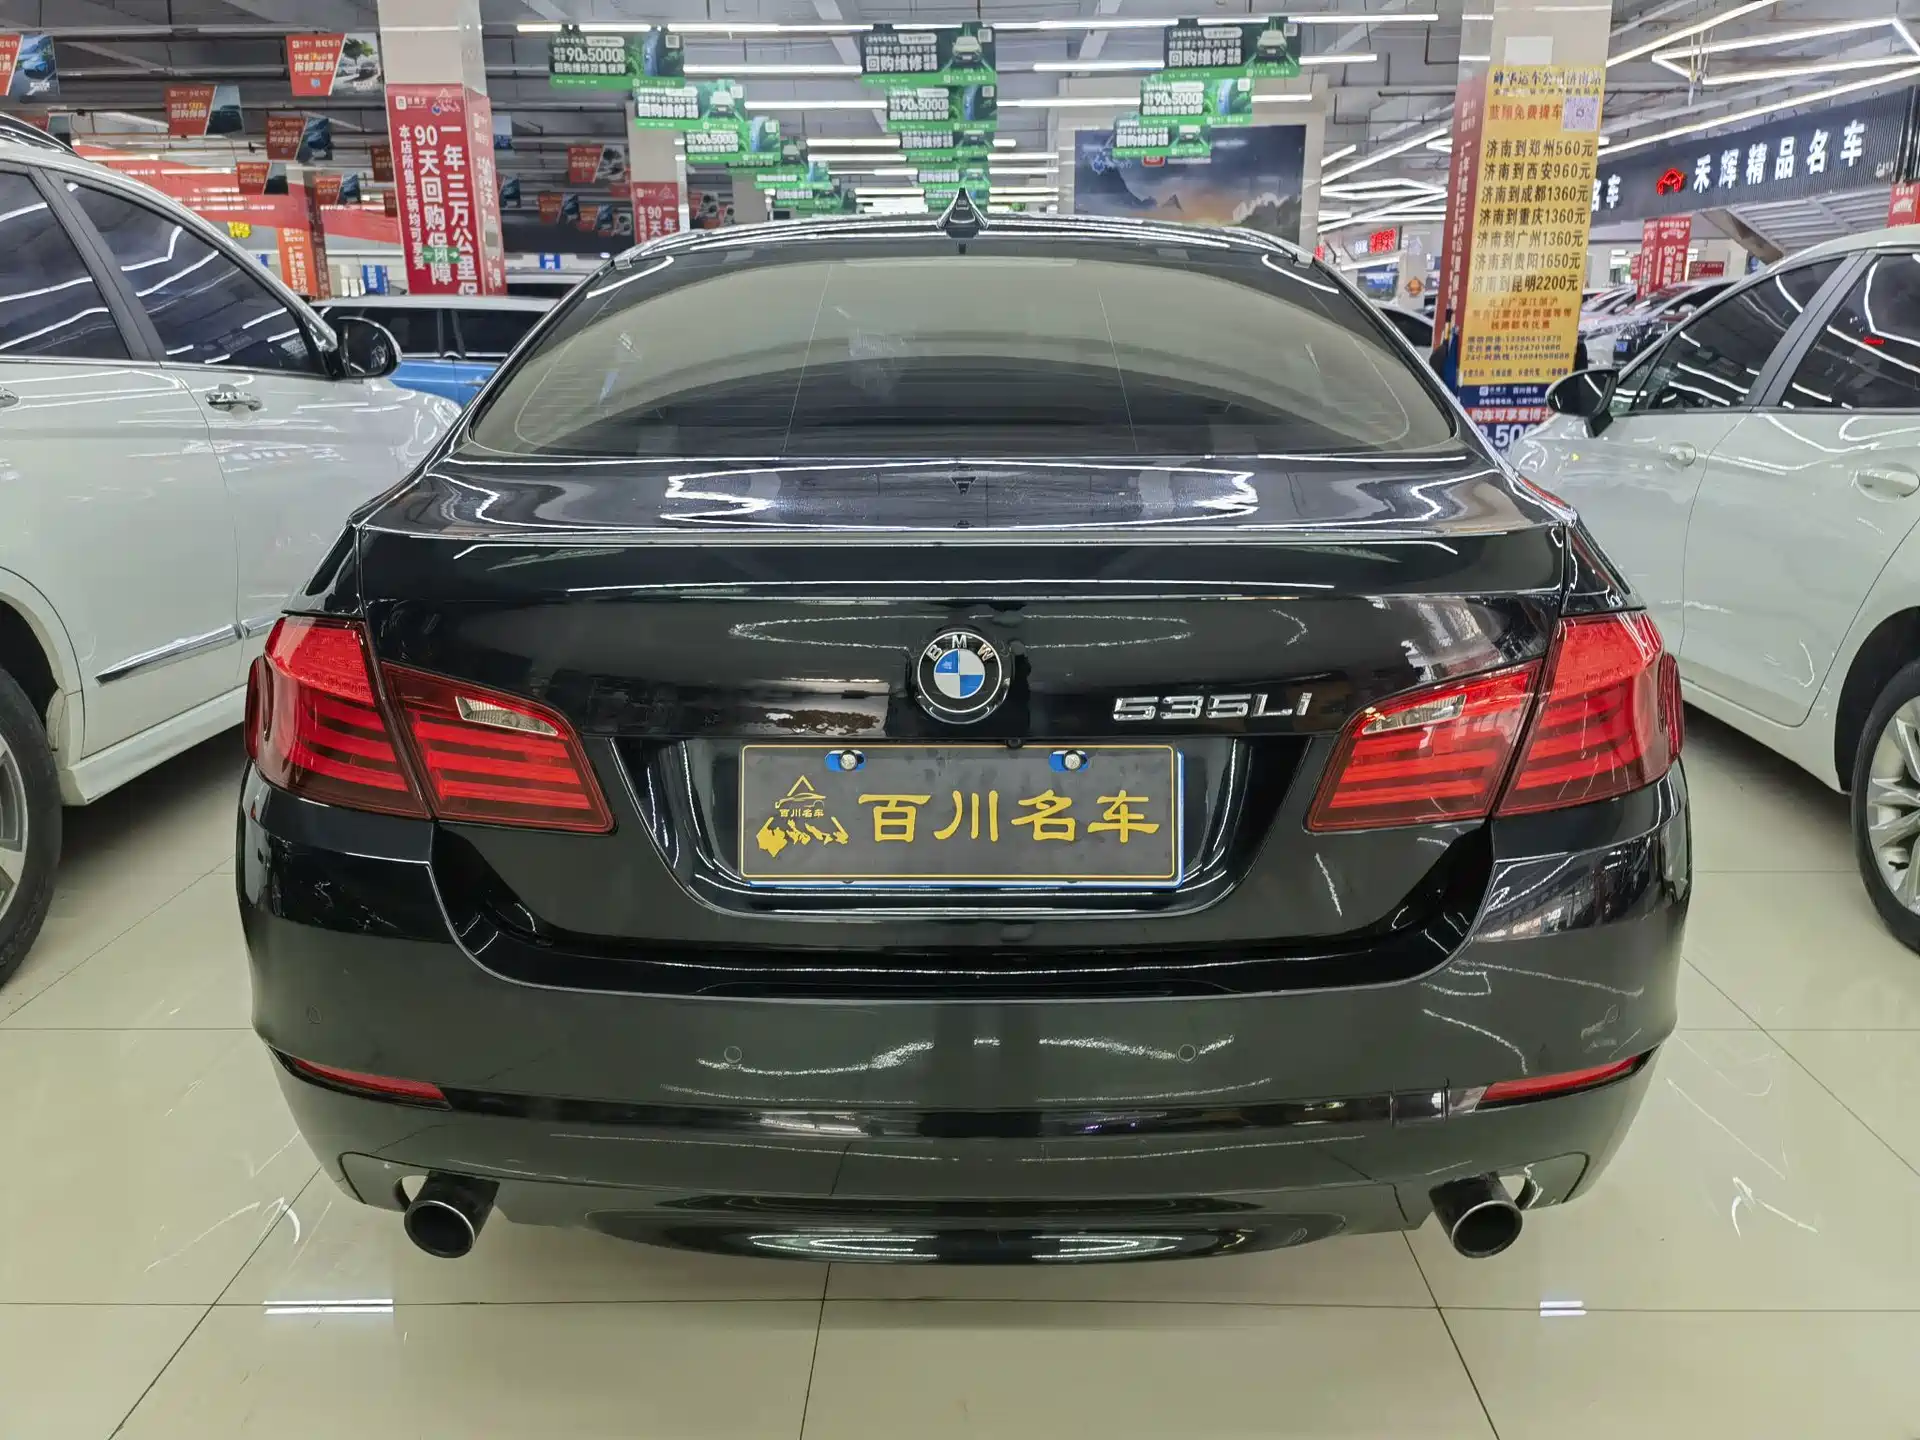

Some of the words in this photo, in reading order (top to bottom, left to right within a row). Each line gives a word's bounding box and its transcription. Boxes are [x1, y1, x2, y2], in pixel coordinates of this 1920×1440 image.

[1485, 139, 1594, 159] 济南到郑州560元
[1693, 119, 1866, 194] 禾辉精品名车
[1483, 160, 1592, 182] 济南到西安960元
[1481, 183, 1589, 204] 济南到成都1360元
[1479, 206, 1586, 227] 济南到重庆1360元
[1476, 229, 1584, 249] 济南到广州1360元
[1474, 251, 1581, 271] 济南到贵阳1650元
[1471, 274, 1579, 293] 济南到昆明2200元
[1111, 691, 1313, 722] 535Li
[779, 807, 825, 819] 百川名车
[857, 788, 1161, 843] 百川名车
